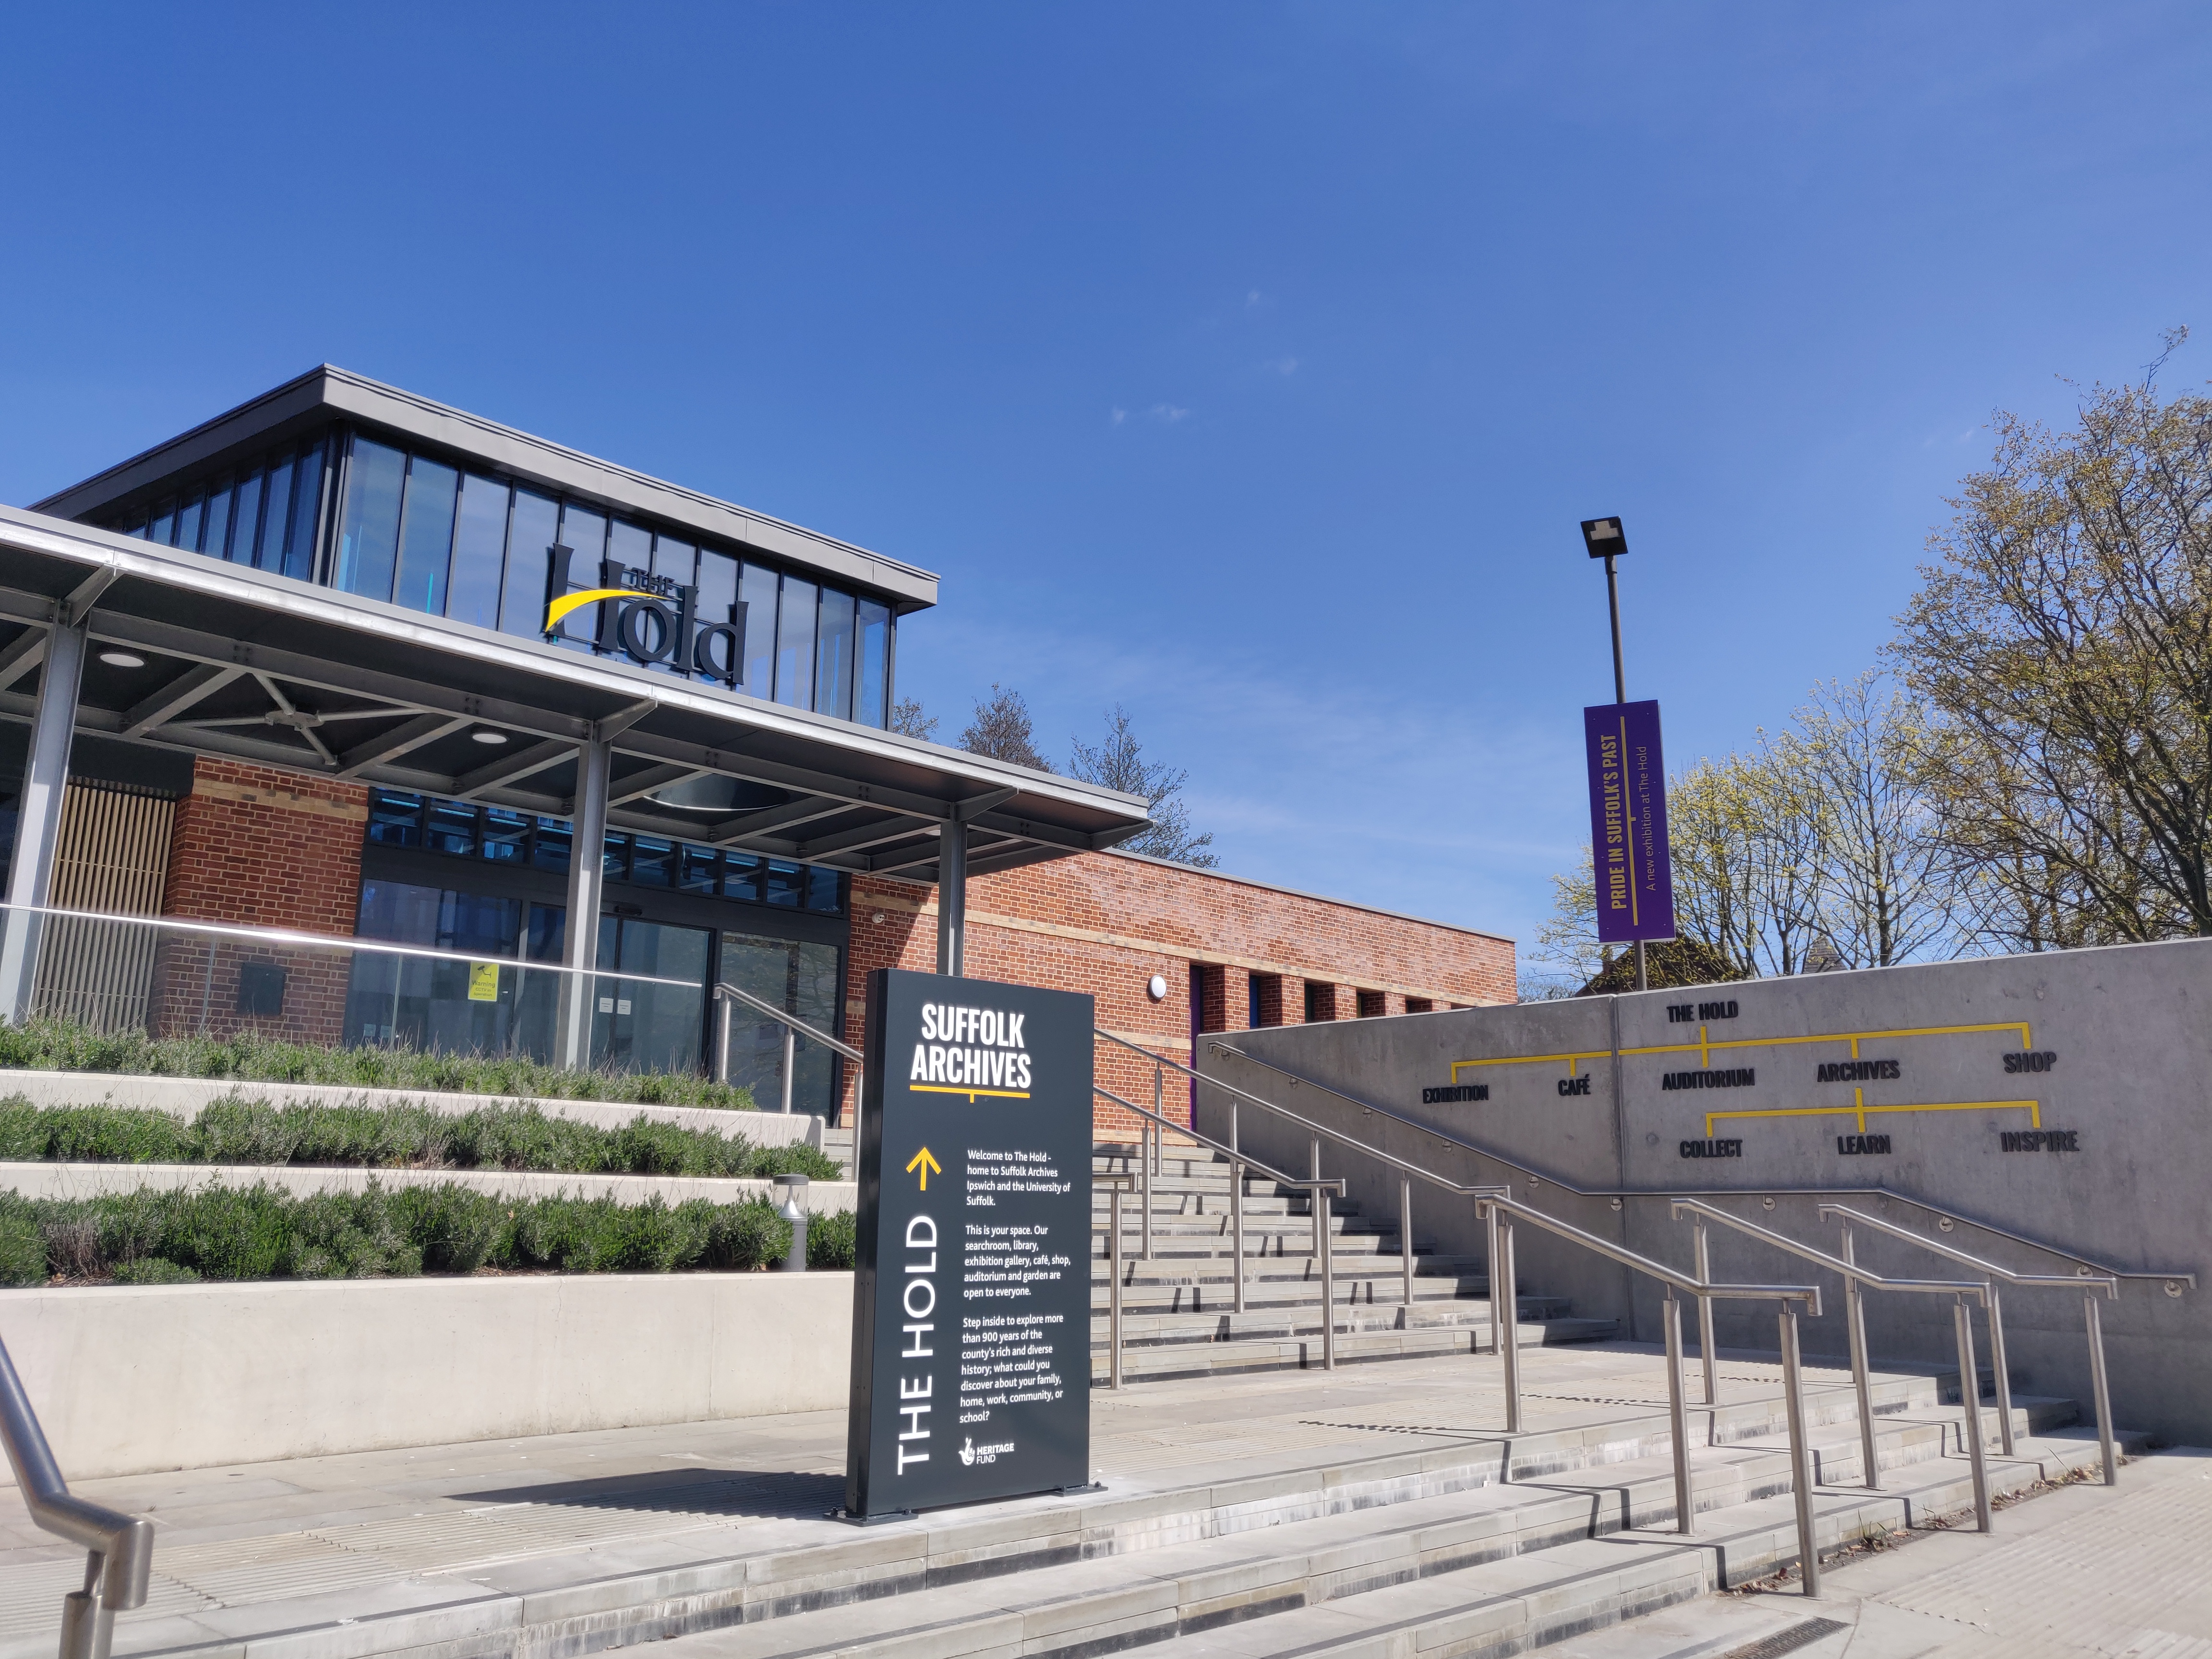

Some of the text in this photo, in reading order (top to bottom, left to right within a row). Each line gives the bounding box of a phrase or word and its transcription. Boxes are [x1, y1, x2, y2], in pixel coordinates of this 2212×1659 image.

[631, 567, 675, 598] THE
[545, 543, 749, 685] Hold
[1600, 735, 1627, 909] PRIDE IN SUFFOLK'S PAST
[1635, 746, 1656, 891] A new exhibition at The Hold
[1667, 1001, 1739, 1022] THE HOLD
[922, 1004, 1024, 1048] SUFFOLK
[910, 1045, 1031, 1088] ARCHIVES
[1817, 1060, 1900, 1082] ARCHIVES
[2003, 1052, 2057, 1073] SHOP
[1558, 1074, 1591, 1096] CAFÉ
[1662, 1069, 1755, 1091] AUDITORIUM
[1422, 1085, 1489, 1104] EXHIBITION
[1680, 1139, 1743, 1159] COLLECT
[1838, 1135, 1891, 1155] LEARN
[2000, 1130, 2080, 1152] INSPIRE
[967, 1150, 1003, 1160] Welcome
[1004, 1152, 1013, 1161] to
[1014, 1152, 1028, 1161] The
[1029, 1153, 1046, 1162] Hold
[967, 1165, 1058, 1177] home to Suffolk Archives
[967, 1180, 1070, 1194] Ipswich and the University of
[966, 1196, 996, 1205] Suffolk.
[965, 1225, 1048, 1237] This is your space. Our
[965, 1240, 1038, 1252] searchroom, library,
[964, 1255, 1070, 1268] exhibition gallery, café, shop,
[964, 1272, 1006, 1282] auditorium
[1008, 1271, 1022, 1280] and
[1023, 1271, 1048, 1283] garden
[964, 1287, 1031, 1300] open to everyone.
[963, 1314, 1063, 1329] Step inside to explore more
[897, 1215, 937, 1475] THE HOLD
[962, 1330, 1042, 1344] than 900 years of the
[962, 1345, 1053, 1360] county's rich and diverse
[961, 1360, 1050, 1376] history; what could you
[961, 1374, 1061, 1391] discover about your family,
[960, 1397, 985, 1407] home,
[986, 1393, 1008, 1405] work,
[1010, 1390, 1054, 1403] community,
[960, 1411, 989, 1423] school?
[977, 1443, 1014, 1455] HERITAGE
[977, 1455, 996, 1464] FUND
